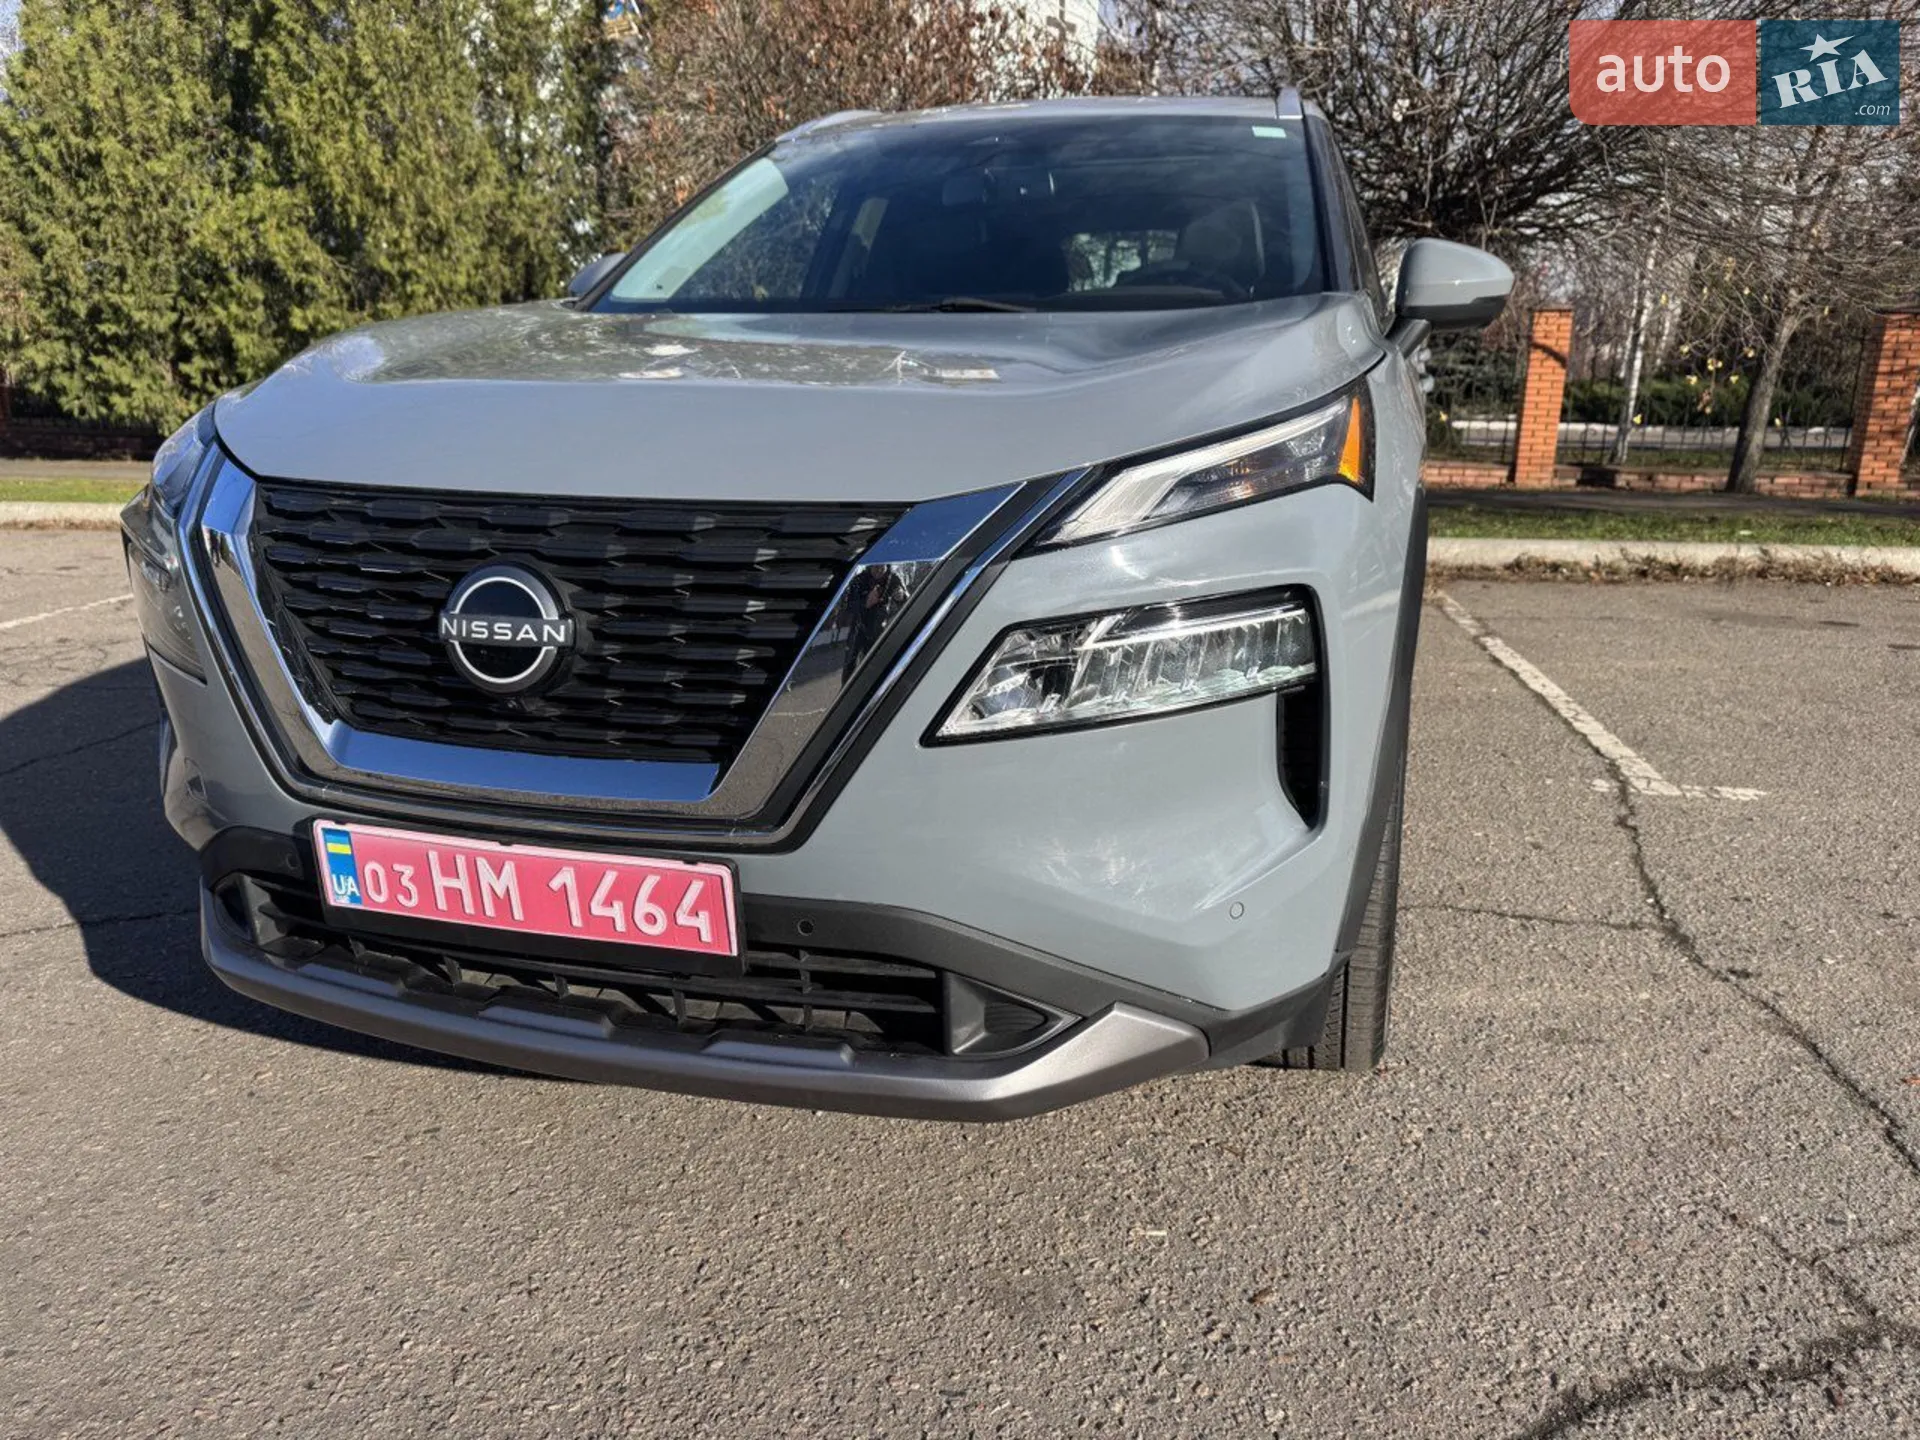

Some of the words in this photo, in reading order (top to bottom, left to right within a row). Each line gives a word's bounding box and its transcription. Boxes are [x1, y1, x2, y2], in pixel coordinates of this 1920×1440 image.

[441, 617, 566, 642] NISSAN
[331, 873, 360, 897] UA
[364, 861, 419, 907] 03
[428, 850, 525, 922] HM
[548, 866, 712, 943] 1464
